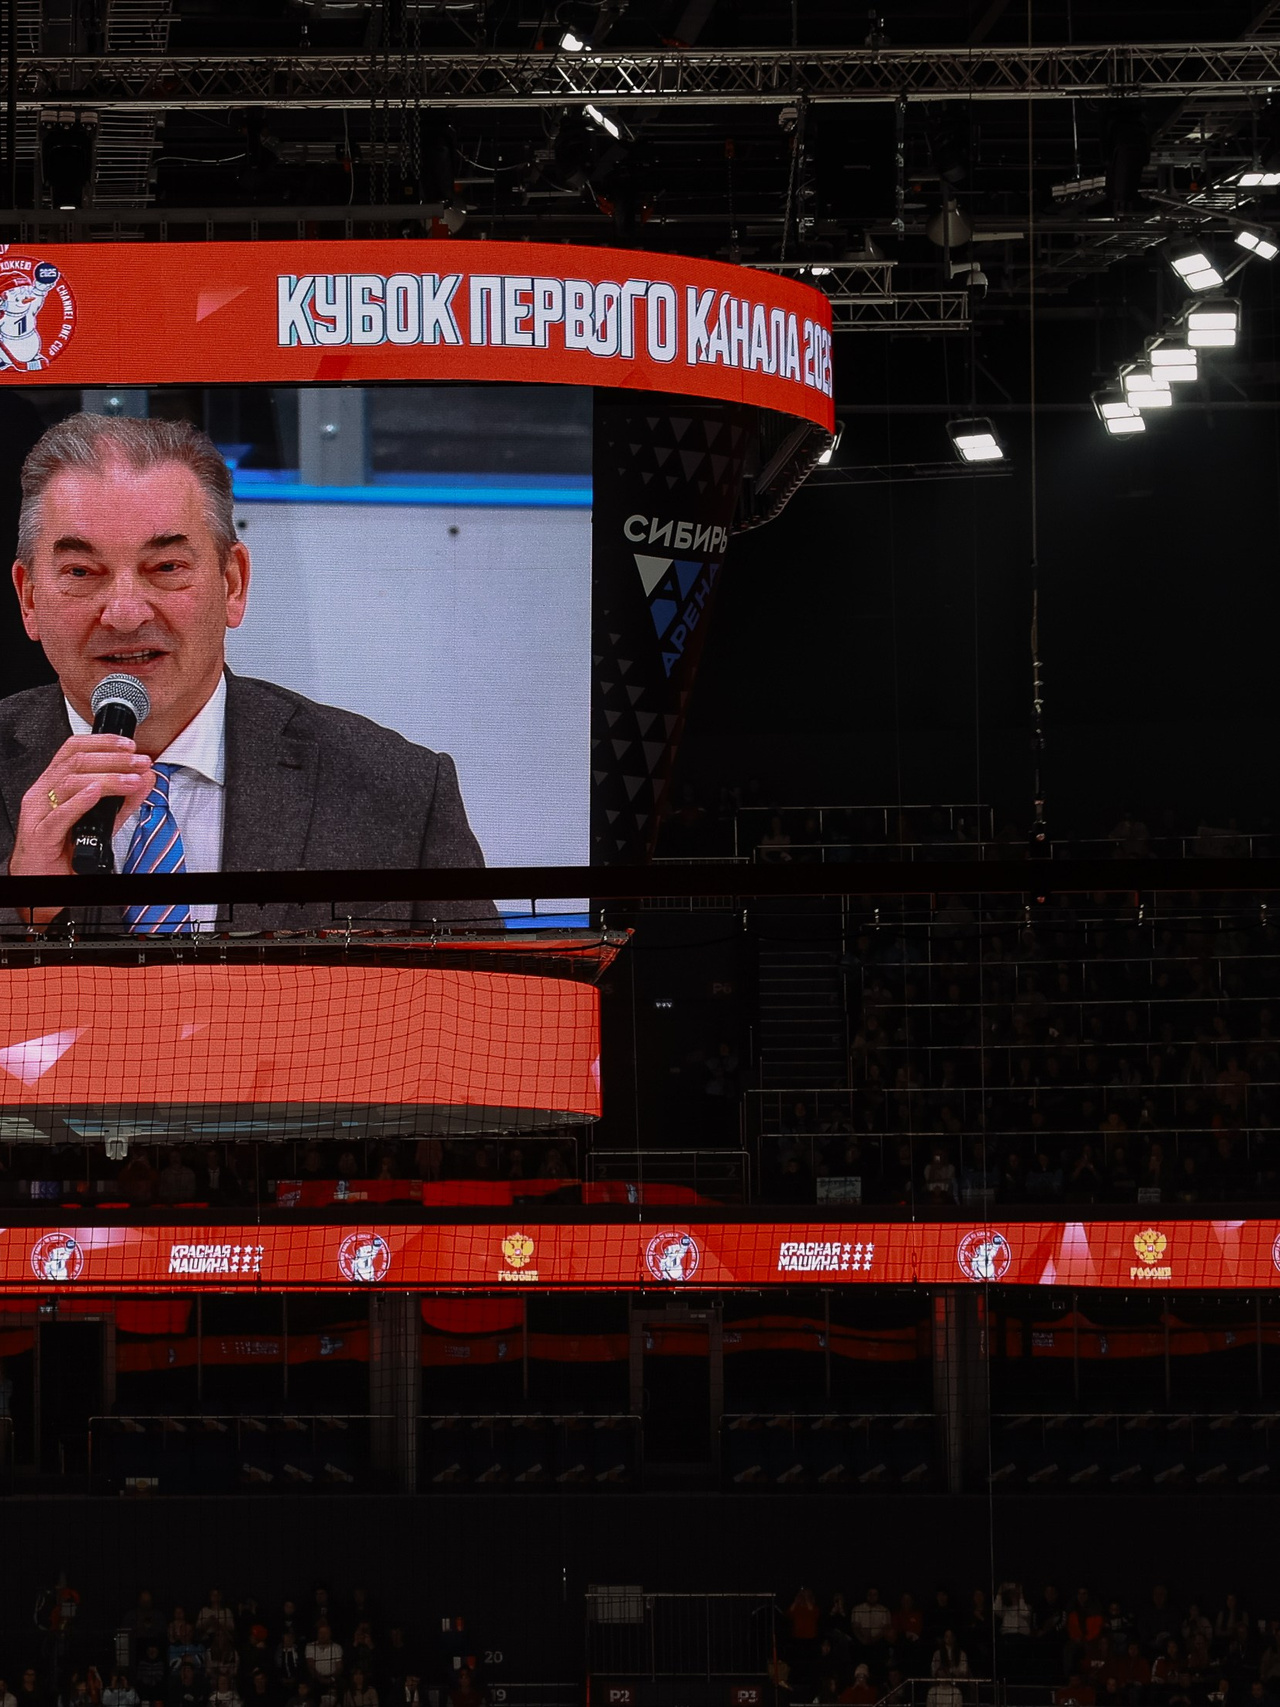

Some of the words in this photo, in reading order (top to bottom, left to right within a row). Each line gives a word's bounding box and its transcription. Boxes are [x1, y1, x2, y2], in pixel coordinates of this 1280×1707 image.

[56, 284, 75, 320] CHANNEL
[58, 323, 72, 341] ONE
[277, 273, 463, 347] КУБОК
[469, 274, 678, 363] ПЕРВОГО
[686, 285, 802, 383] КАНАЛА
[48, 340, 64, 356] CUP
[623, 514, 728, 554] СИБИРЬ
[661, 563, 720, 679] АРЕНА
[76, 838, 98, 846] MIC
[170, 1245, 232, 1258] КРАСНАЯ
[780, 1242, 841, 1256] КРАСНАЯ
[168, 1258, 229, 1273] МАШИНА
[777, 1256, 839, 1271] МАШИНА
[484, 1650, 503, 1663] 20
[609, 1690, 630, 1702] P2
[738, 1690, 758, 1702] P3
